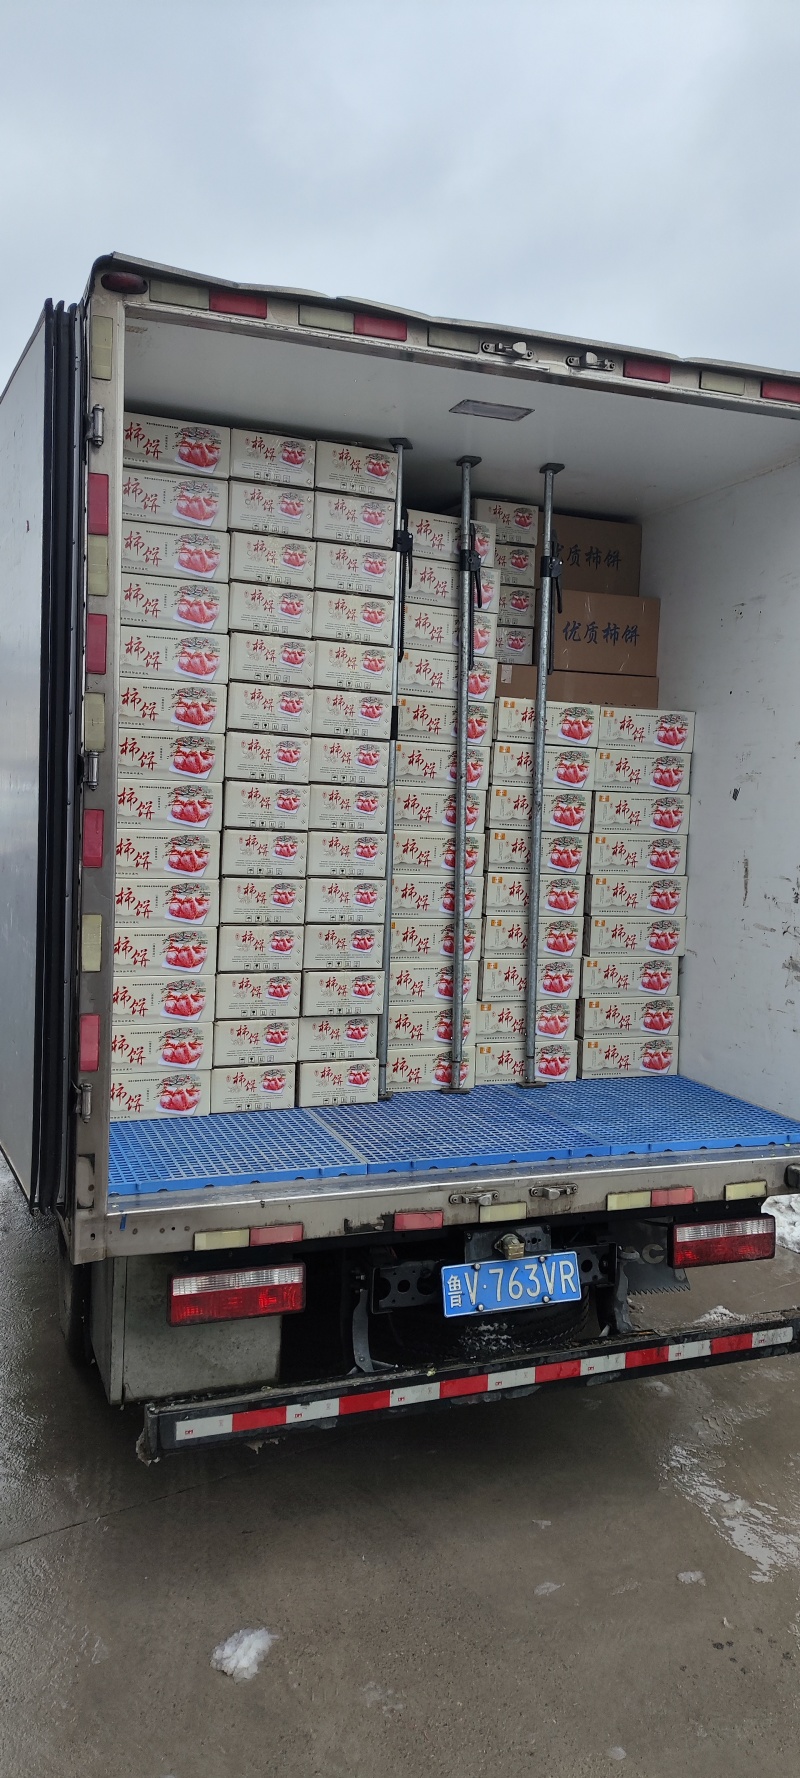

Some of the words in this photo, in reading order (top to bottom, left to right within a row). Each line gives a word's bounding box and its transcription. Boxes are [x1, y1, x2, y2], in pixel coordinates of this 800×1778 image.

[125, 422, 162, 459] 柿饼
[254, 436, 276, 459] 柿饼
[339, 448, 361, 473] 柿饼
[123, 478, 160, 510] 柿饼
[250, 489, 275, 512] 柿饼
[334, 499, 357, 521] 柿饼
[492, 505, 511, 524] 柿饼
[416, 519, 446, 550] 柿饼
[125, 530, 162, 567] 柿饼
[253, 539, 278, 564] 柿饼
[335, 548, 358, 573] 柿饼
[420, 566, 449, 598] 柿饼
[124, 583, 162, 618] 柿饼
[250, 588, 275, 614] 柿饼
[335, 598, 357, 622] 柿饼
[415, 612, 444, 644] 柿饼
[562, 620, 640, 647] 优质柿饼
[125, 636, 162, 671] 柿饼
[251, 639, 276, 661] 柿饼
[334, 648, 357, 670] 柿饼
[416, 659, 445, 690] 柿饼
[121, 688, 159, 722] 柿饼
[250, 690, 274, 714] 柿饼
[332, 695, 356, 717] 柿饼
[413, 706, 441, 735] 柿饼
[620, 715, 646, 742] 柿饼
[120, 737, 158, 771] 柿饼
[248, 739, 271, 762] 柿饼
[330, 743, 354, 765] 柿饼
[408, 750, 437, 780] 柿饼
[616, 757, 642, 784] 柿饼
[117, 787, 155, 820] 柿饼
[247, 789, 271, 809] 柿饼
[329, 790, 351, 813] 柿饼
[404, 794, 433, 822] 柿饼
[615, 799, 641, 826] 柿饼
[115, 839, 152, 870] 柿饼
[245, 835, 269, 856] 柿饼
[329, 837, 351, 857] 柿饼
[402, 839, 432, 866] 柿饼
[612, 842, 638, 867] 柿饼
[115, 888, 153, 918] 柿饼
[243, 884, 267, 905] 柿饼
[329, 883, 351, 905] 柿饼
[401, 884, 429, 911] 柿饼
[612, 882, 638, 909] 柿饼
[240, 930, 265, 951] 柿饼
[324, 931, 347, 952] 柿饼
[402, 926, 431, 953] 柿饼
[611, 924, 637, 949] 柿饼
[114, 937, 149, 968] 柿饼
[238, 978, 262, 999] 柿饼
[325, 978, 348, 999] 柿饼
[397, 970, 424, 997] 柿饼
[604, 964, 630, 990] 柿饼
[113, 985, 148, 1017] 柿饼
[394, 1014, 424, 1041] 柿饼
[498, 1010, 525, 1037] 柿饼
[605, 1006, 632, 1030] 柿饼
[236, 1024, 258, 1045] 柿饼
[319, 1023, 341, 1043] 柿饼
[111, 1035, 146, 1064] 柿饼
[603, 1046, 630, 1073] 柿饼
[392, 1056, 421, 1083] 柿饼
[497, 1050, 525, 1076] 柿饼
[234, 1072, 257, 1093] 柿饼
[320, 1068, 342, 1087] 柿饼
[110, 1084, 142, 1113] 柿饼
